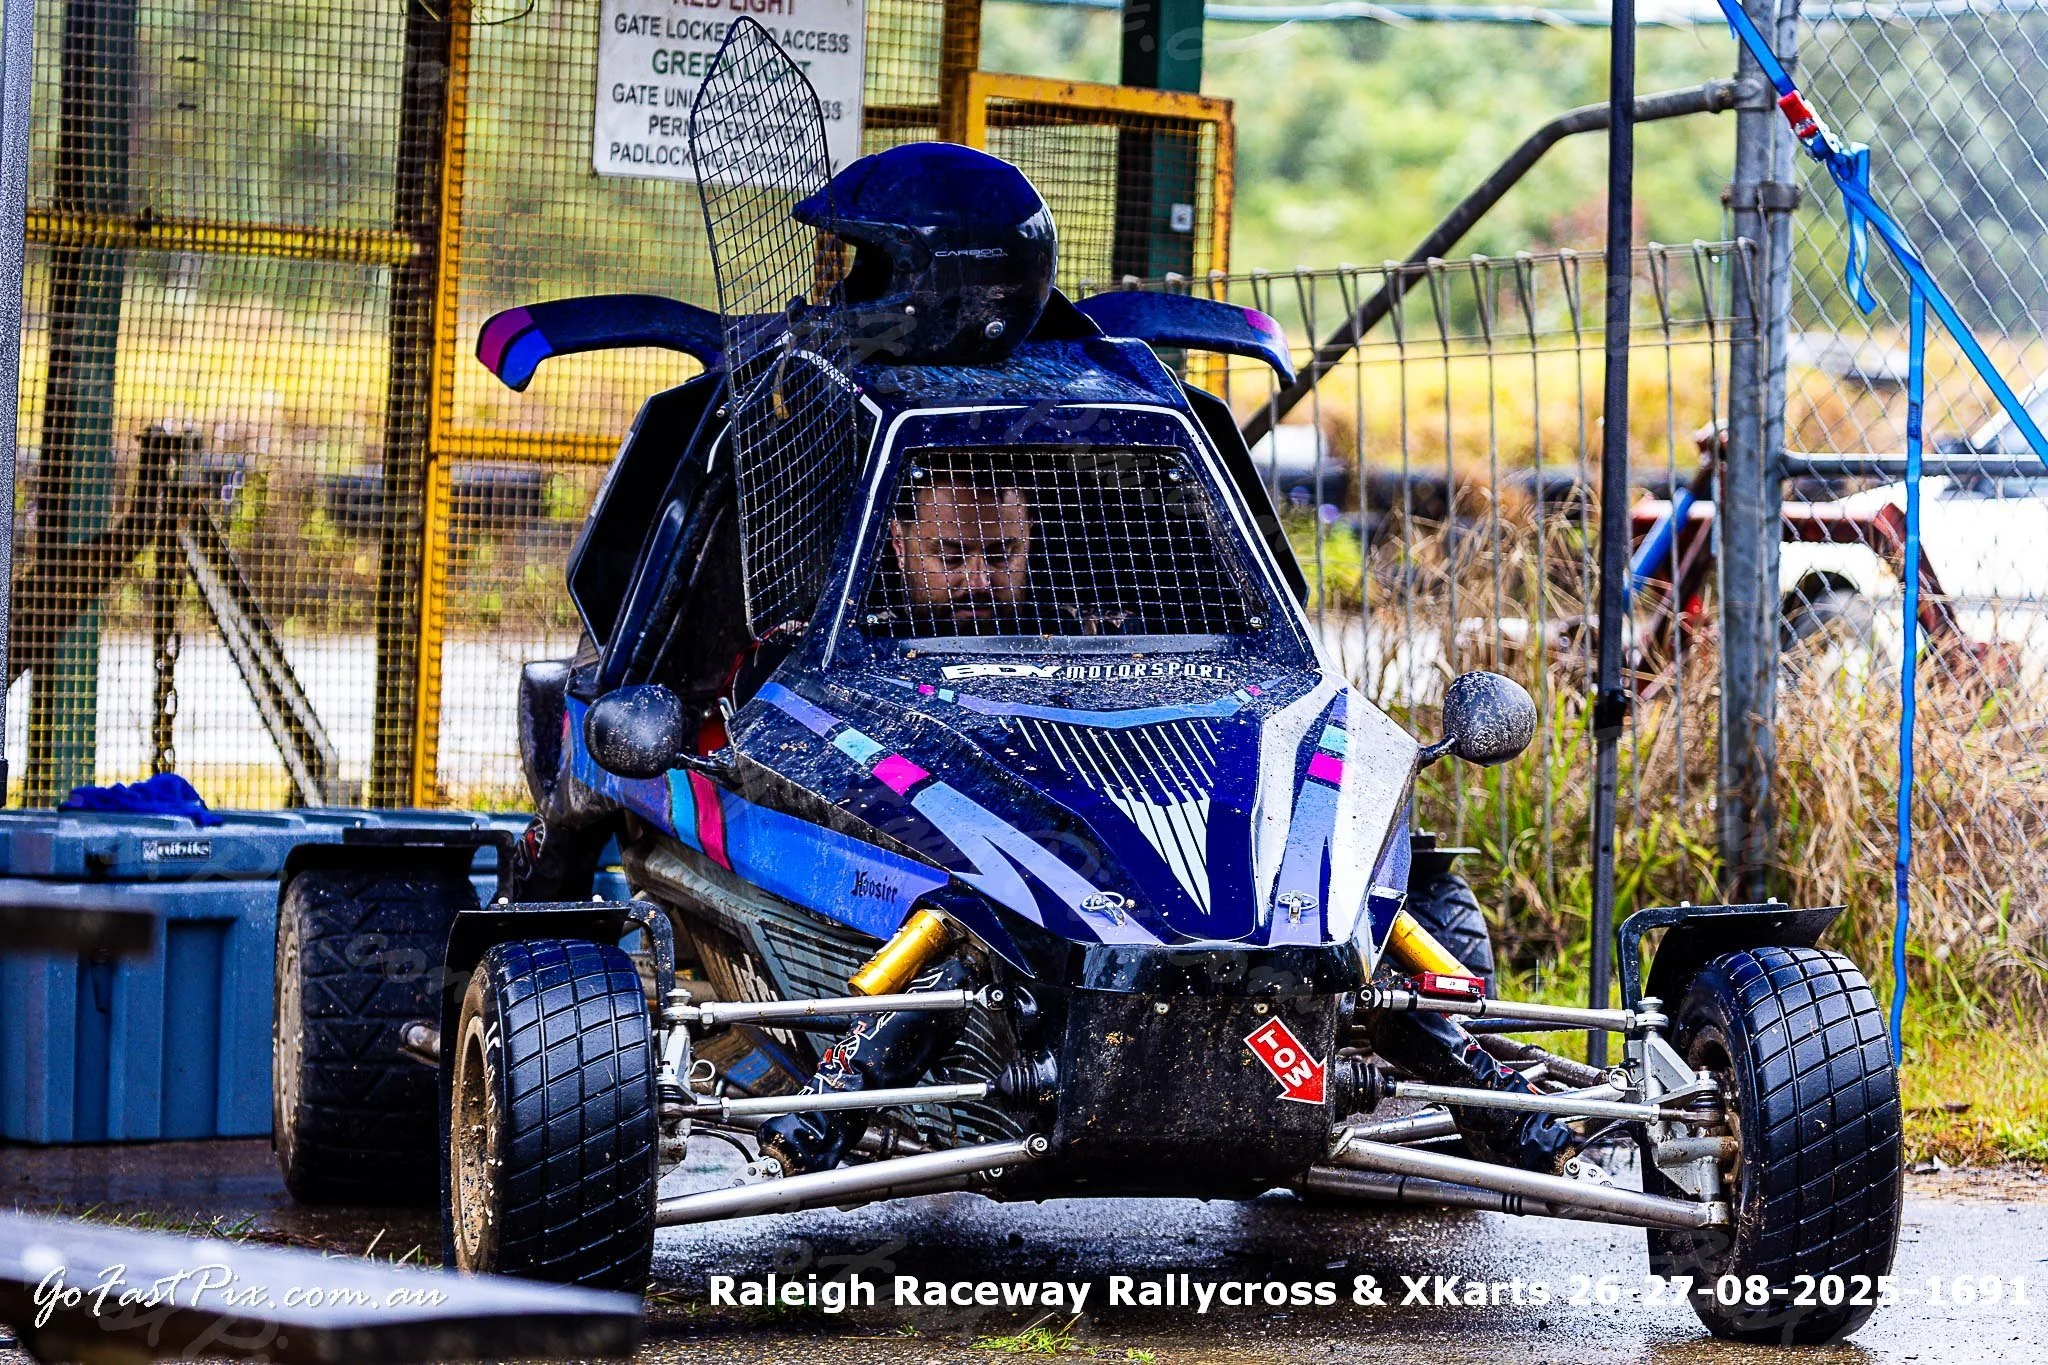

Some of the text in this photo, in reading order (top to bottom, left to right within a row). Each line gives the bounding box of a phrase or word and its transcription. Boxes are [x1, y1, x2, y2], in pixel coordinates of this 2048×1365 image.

[614, 12, 661, 37] GATE
[781, 28, 850, 54] ACCESS
[612, 82, 659, 106] GATE
[609, 141, 723, 169] PADLOCKNG
[934, 248, 1003, 257] CARBON
[1066, 662, 1226, 680] MOTORSPORT
[851, 869, 899, 905] Hoosier
[1256, 1028, 1314, 1088] TOW
